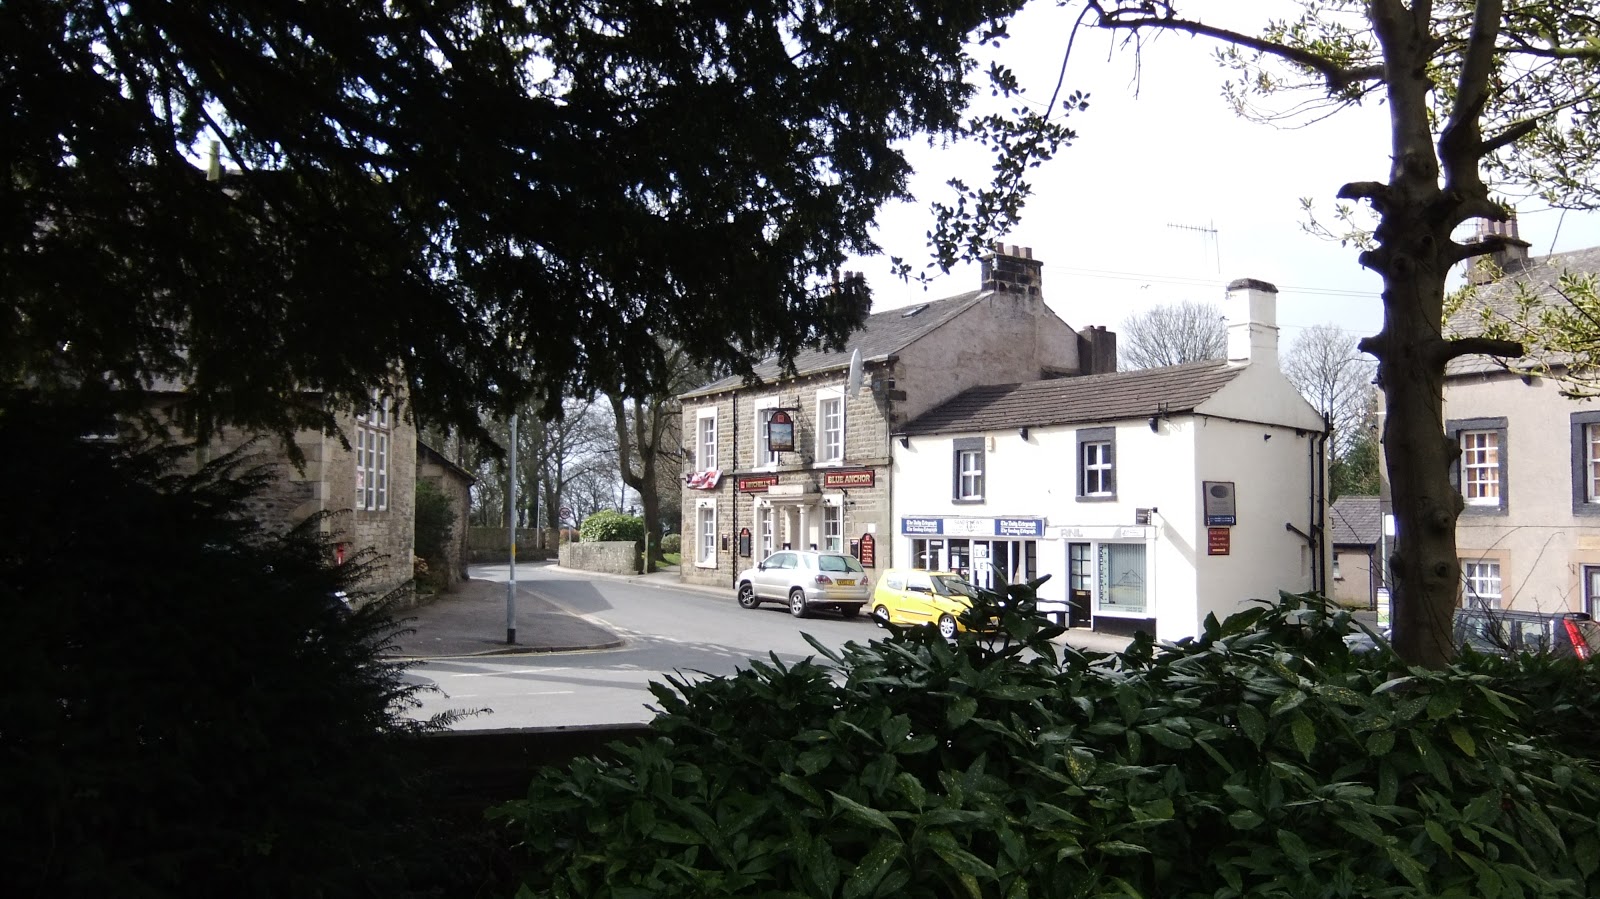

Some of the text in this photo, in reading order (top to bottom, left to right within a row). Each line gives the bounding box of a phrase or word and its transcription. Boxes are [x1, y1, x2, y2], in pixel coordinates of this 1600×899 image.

[827, 474, 871, 484] BLUE ANCHOR
[1017, 520, 1036, 528] Telegraph
[1061, 528, 1083, 537] RNL
[975, 549, 986, 557] TO
[974, 562, 989, 570] LET
